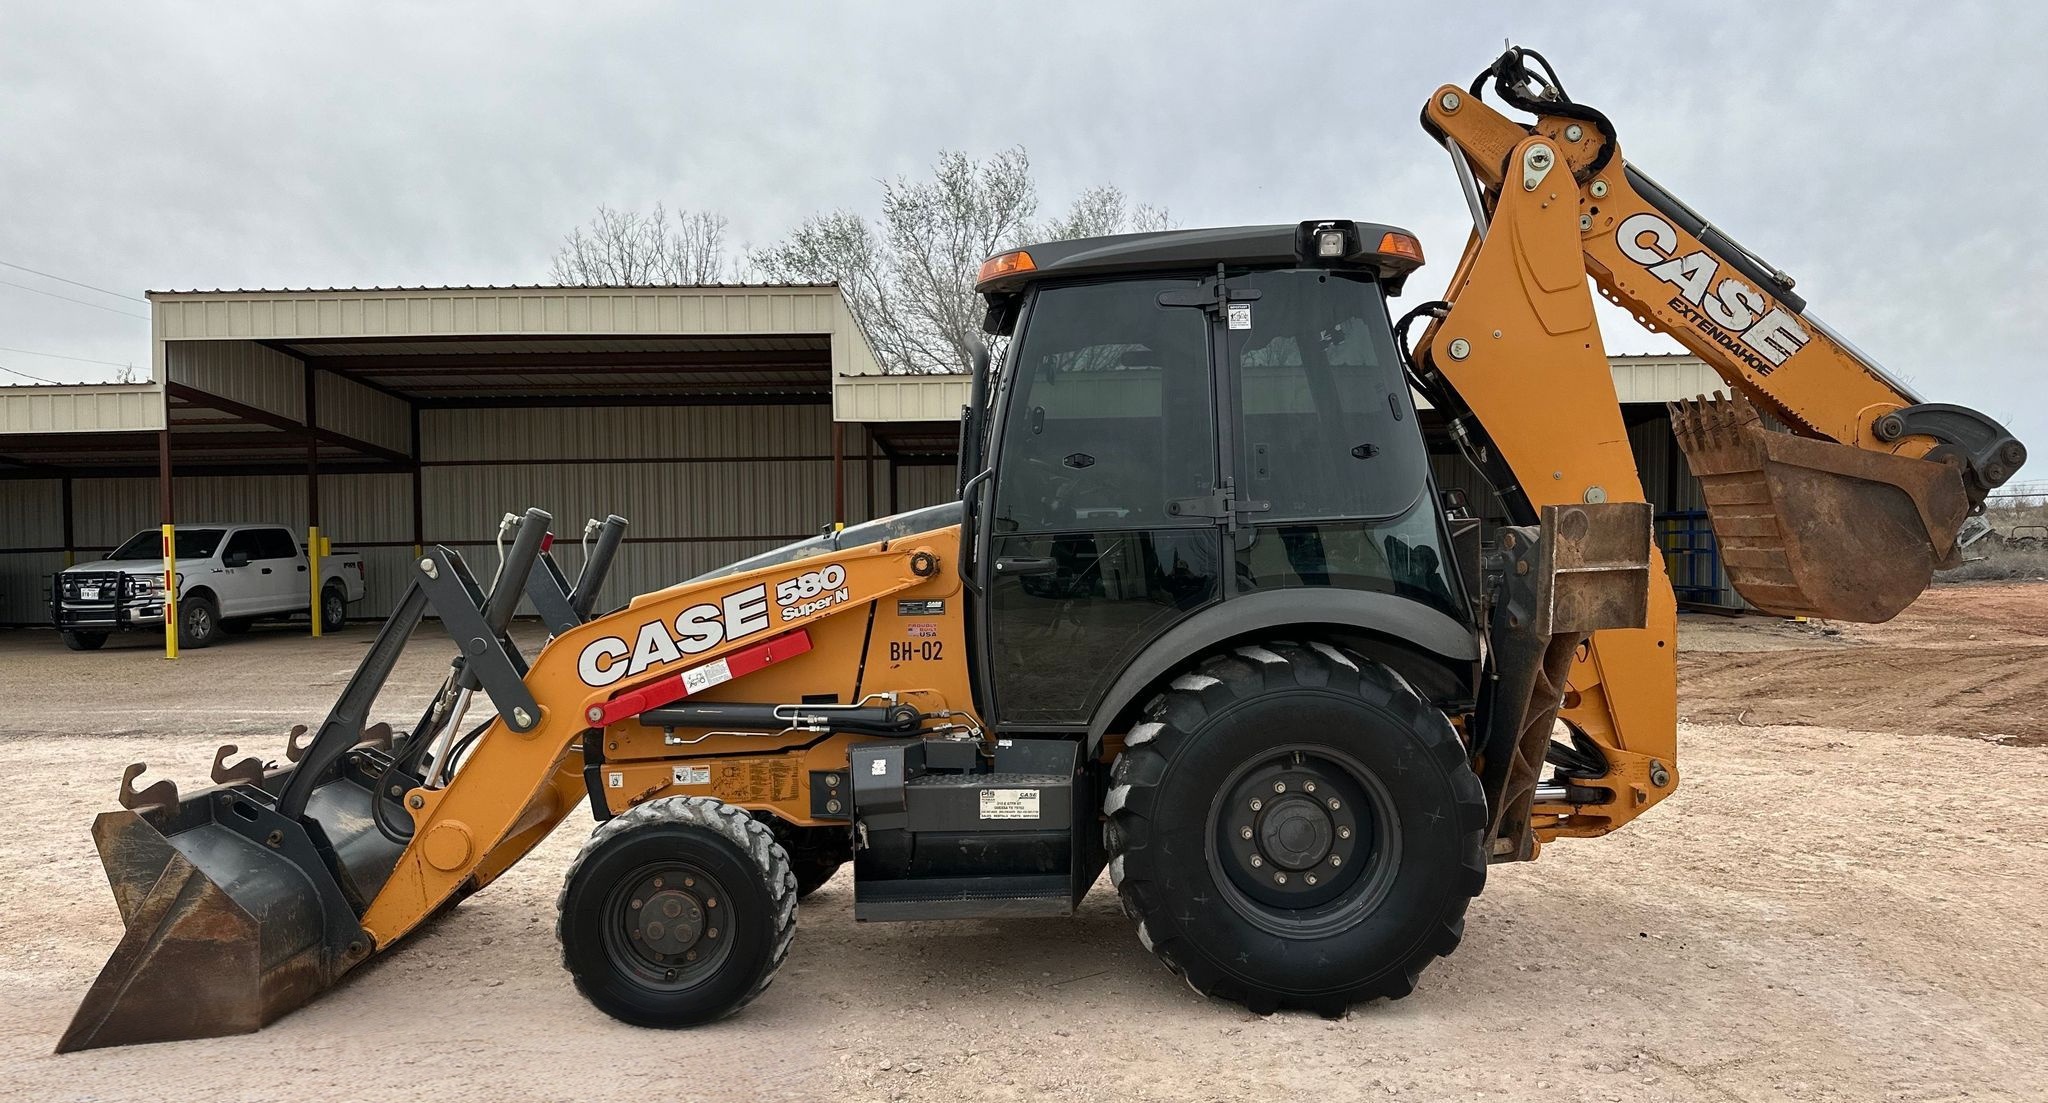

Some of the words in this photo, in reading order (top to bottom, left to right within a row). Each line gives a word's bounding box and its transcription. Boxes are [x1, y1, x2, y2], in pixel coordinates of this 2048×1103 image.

[1616, 213, 1811, 367] CASE
[1667, 297, 1774, 377] EXTENDAHOE
[578, 584, 770, 687] CASE
[775, 563, 847, 607] 580
[781, 594, 833, 622] Super
[834, 586, 849, 604] N
[890, 641, 943, 661] BH-02
